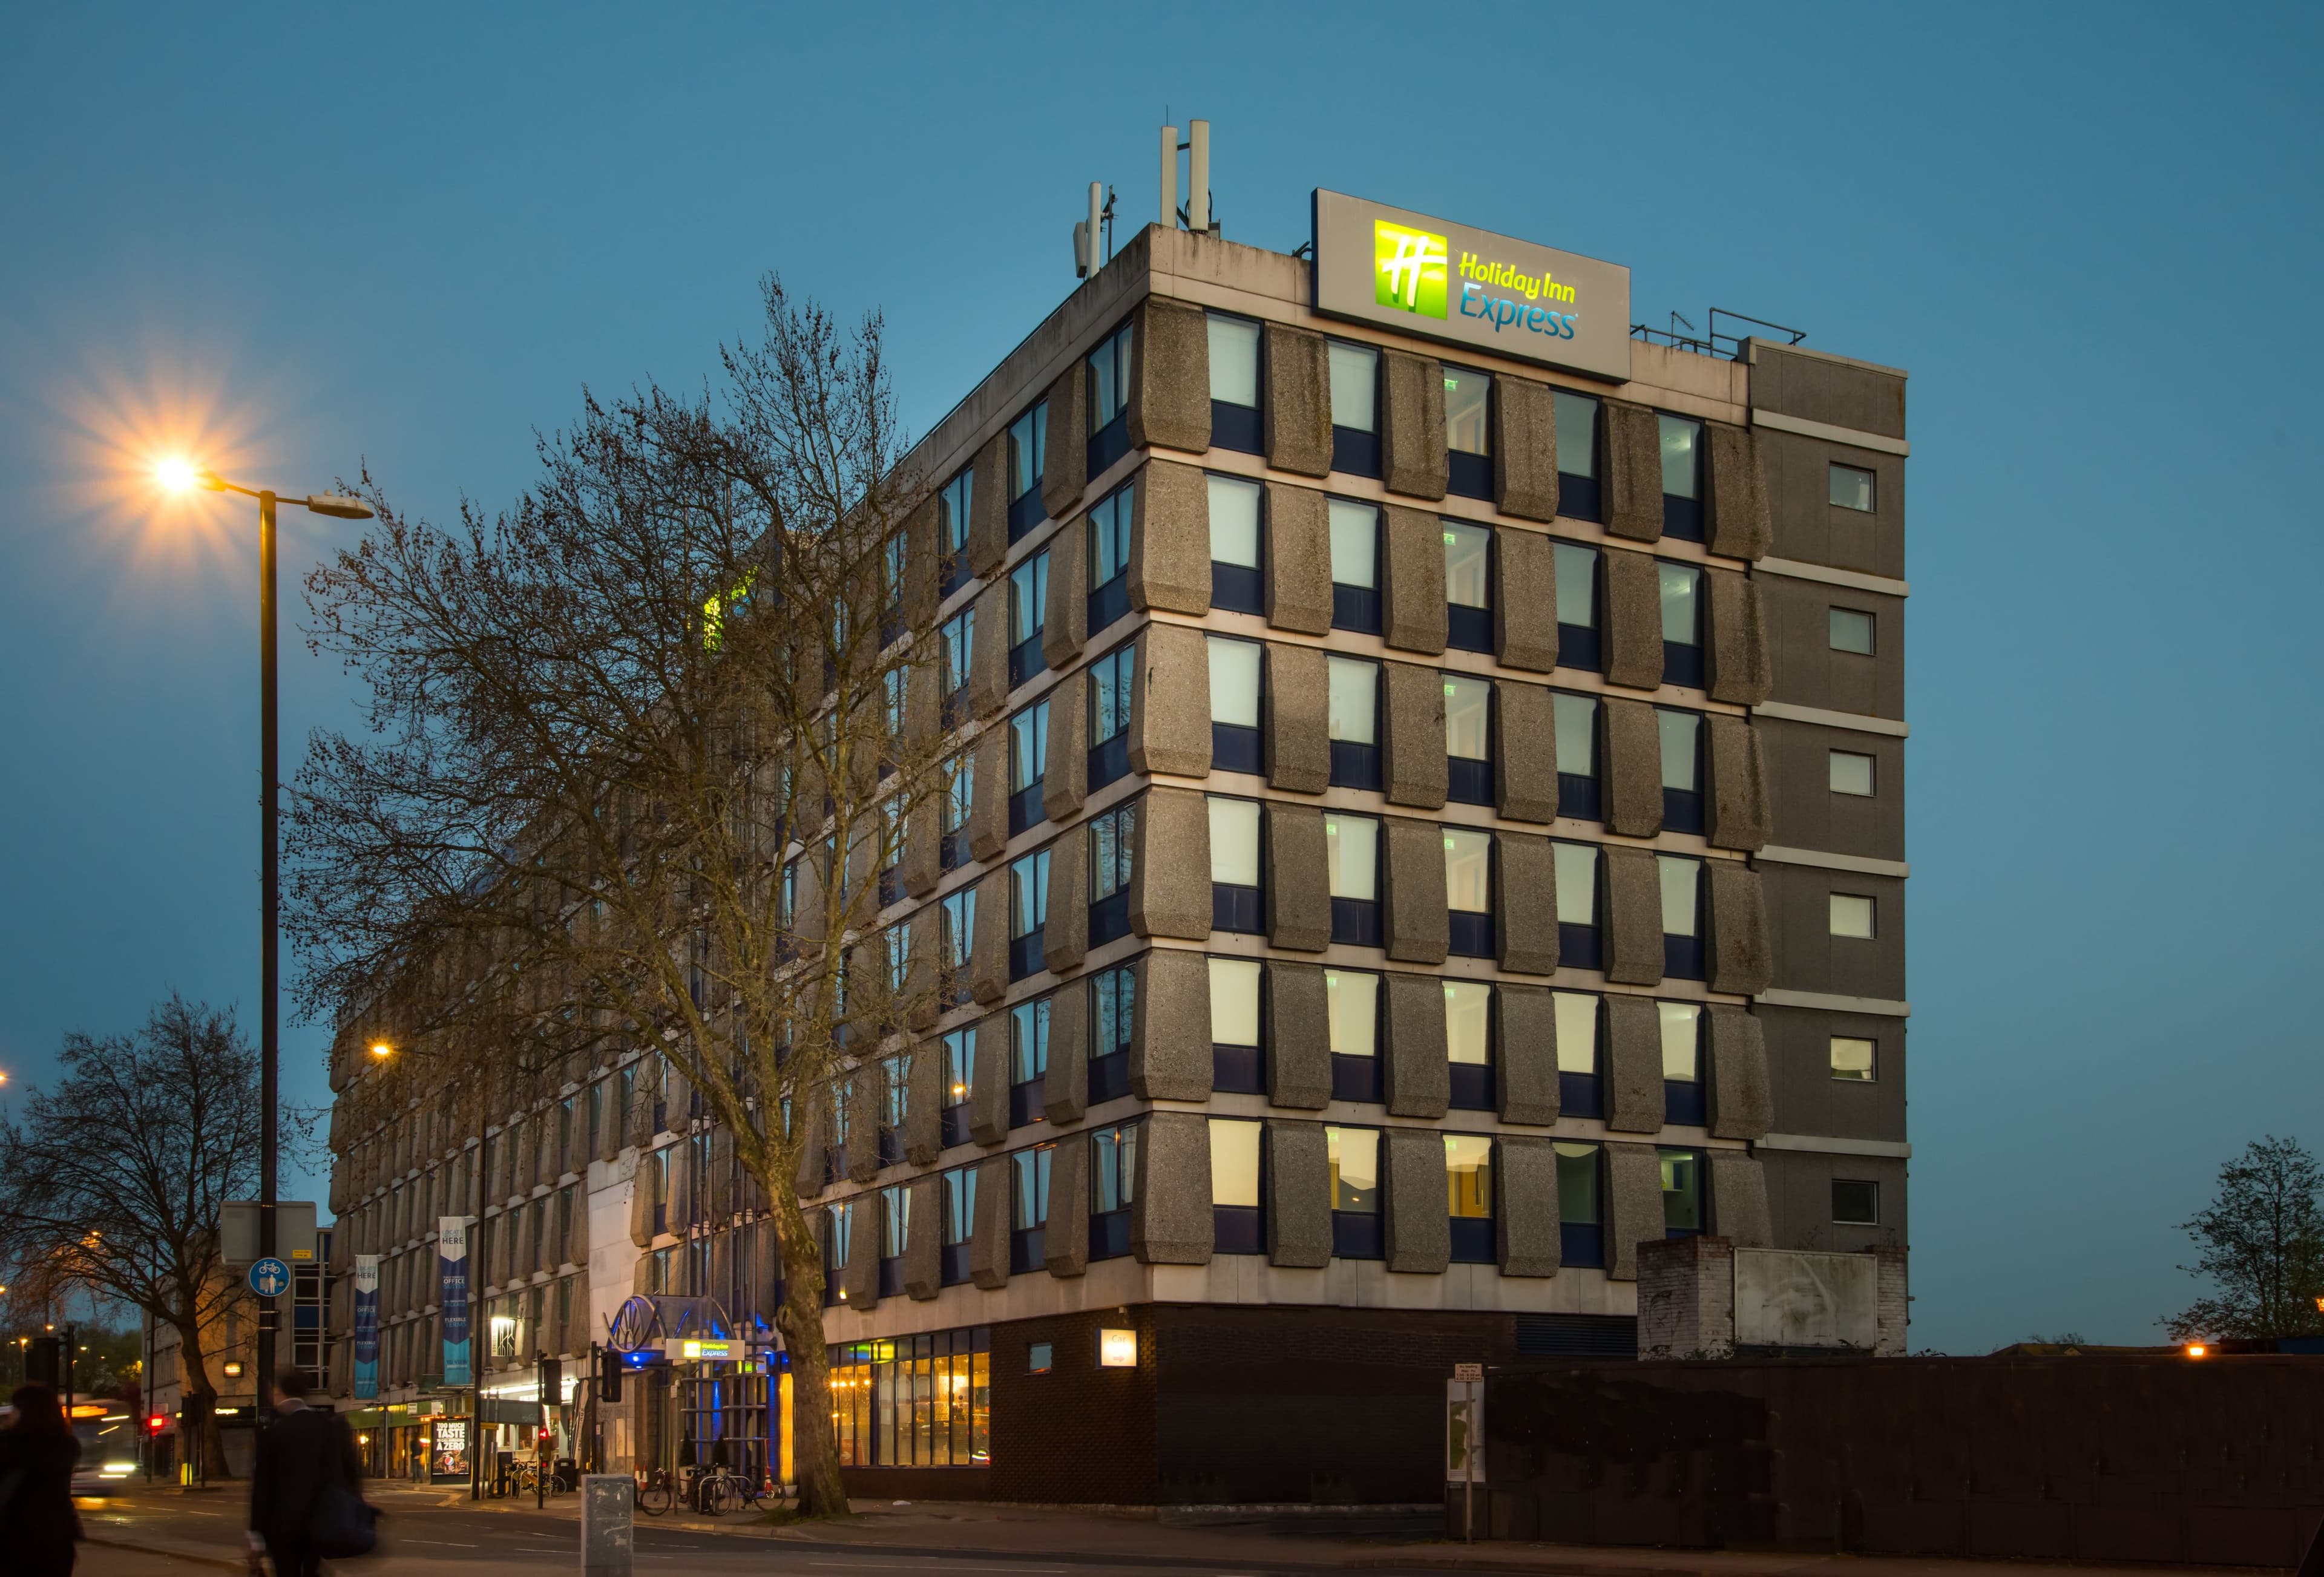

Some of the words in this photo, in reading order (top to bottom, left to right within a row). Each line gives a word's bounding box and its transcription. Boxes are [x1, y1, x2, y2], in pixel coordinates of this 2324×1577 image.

[1459, 252, 1541, 300] Holiday
[1544, 272, 1575, 304] Inn
[1459, 281, 1576, 341] Express
[436, 1442, 442, 1451] A
[444, 1442, 465, 1451] ZERO
[437, 1428, 465, 1438] TASTE
